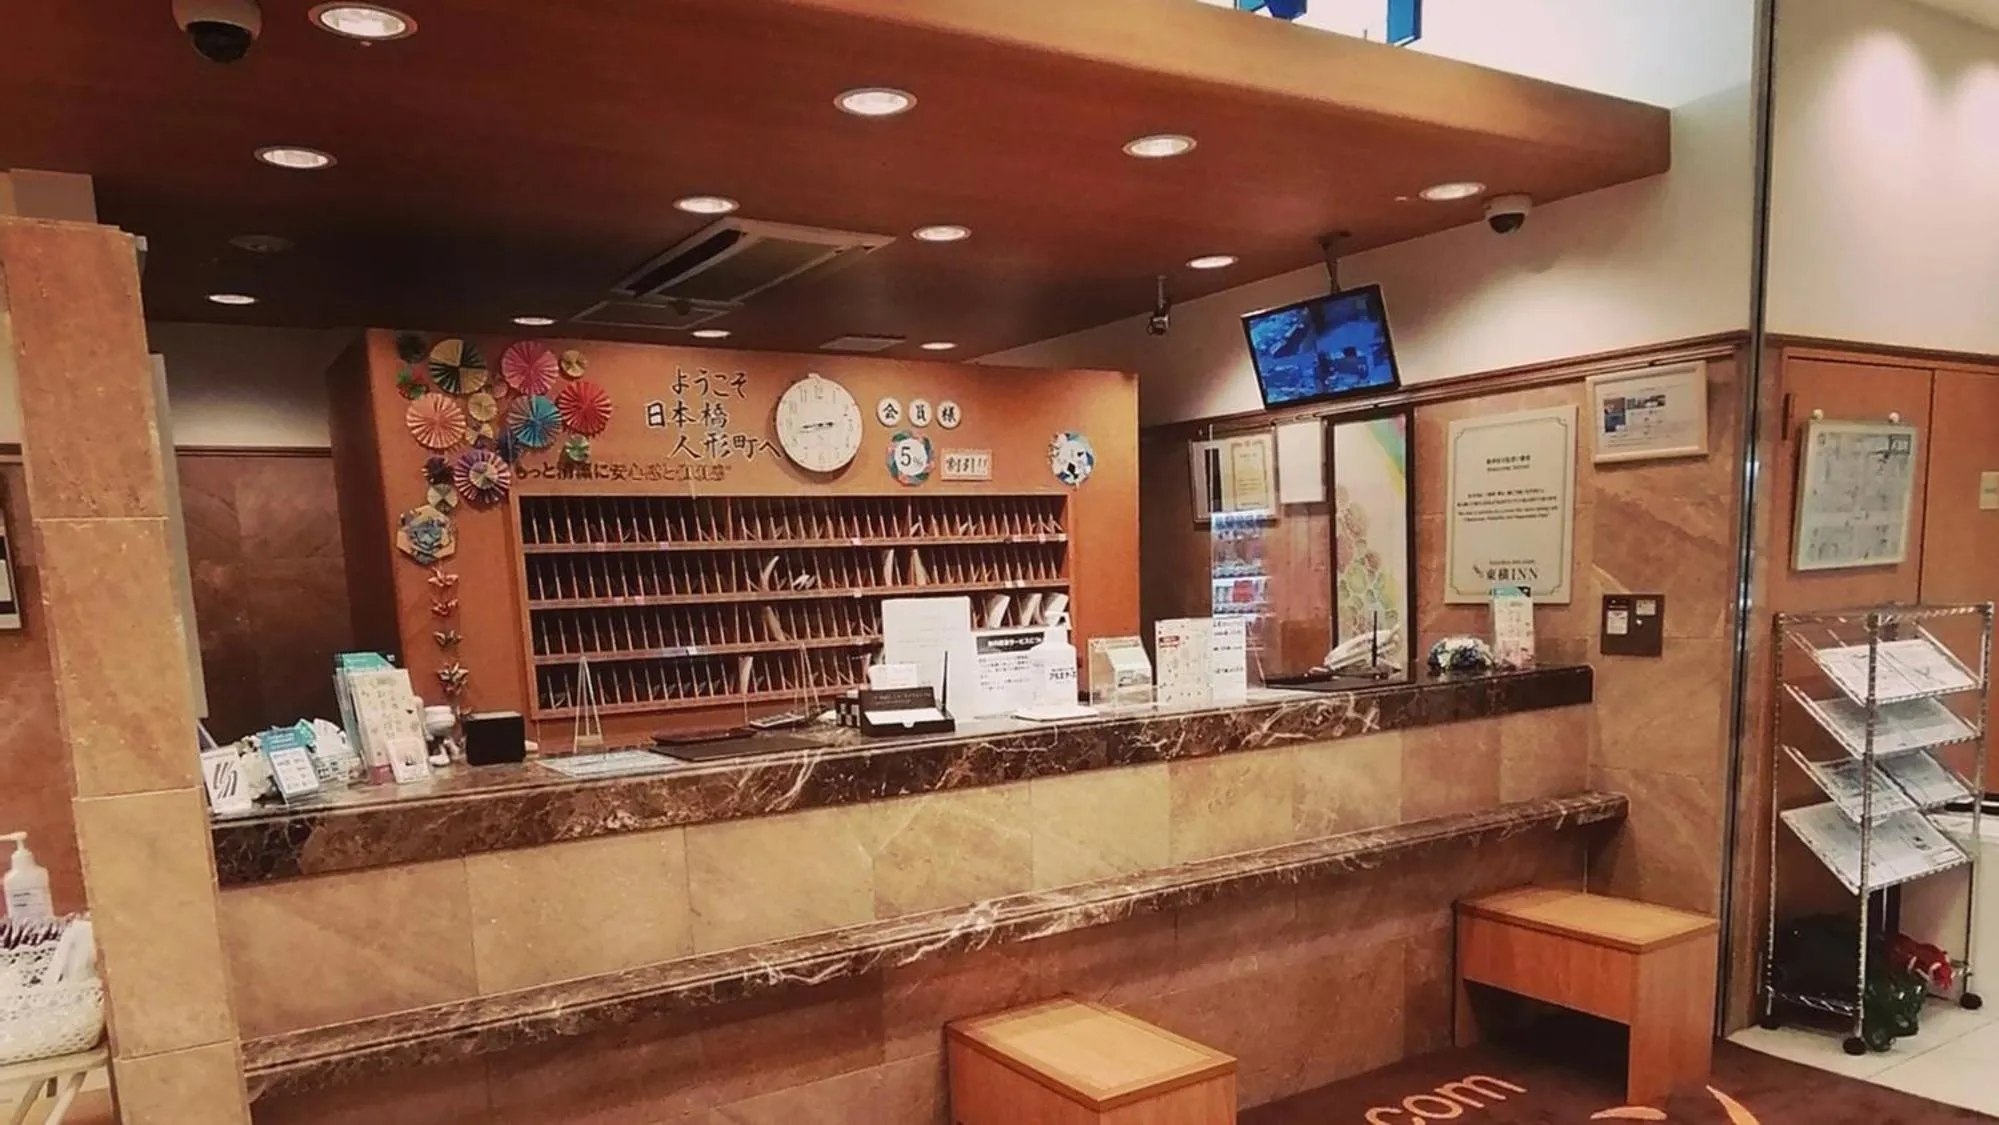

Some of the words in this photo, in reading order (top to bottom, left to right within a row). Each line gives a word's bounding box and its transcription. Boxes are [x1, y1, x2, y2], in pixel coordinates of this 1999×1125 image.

[672, 368, 748, 399] ようこそ
[646, 401, 729, 428] 日本橋
[882, 403, 956, 423] 会員様
[669, 432, 781, 459] 人形町へ
